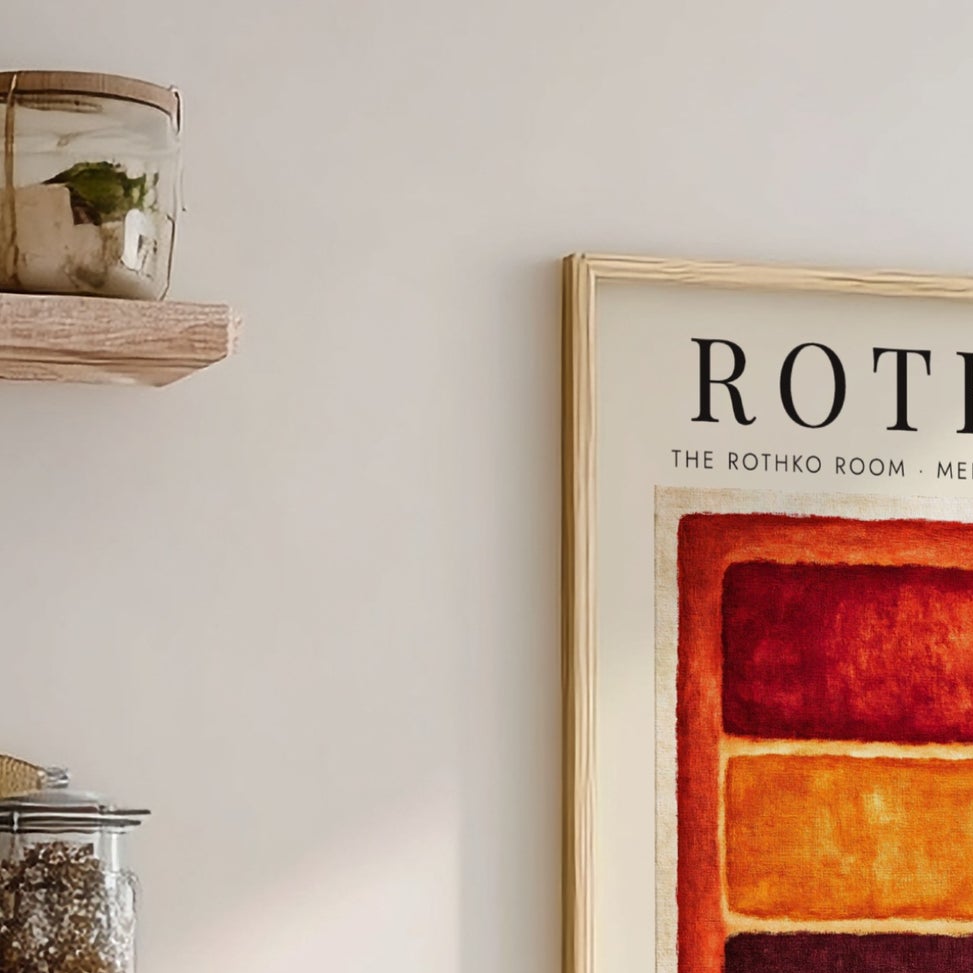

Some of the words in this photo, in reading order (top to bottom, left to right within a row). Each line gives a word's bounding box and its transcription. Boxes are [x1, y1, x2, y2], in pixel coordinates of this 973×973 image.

[671, 448, 714, 470] THE
[728, 451, 822, 474] ROTHKO
[835, 456, 905, 478] ROOM
